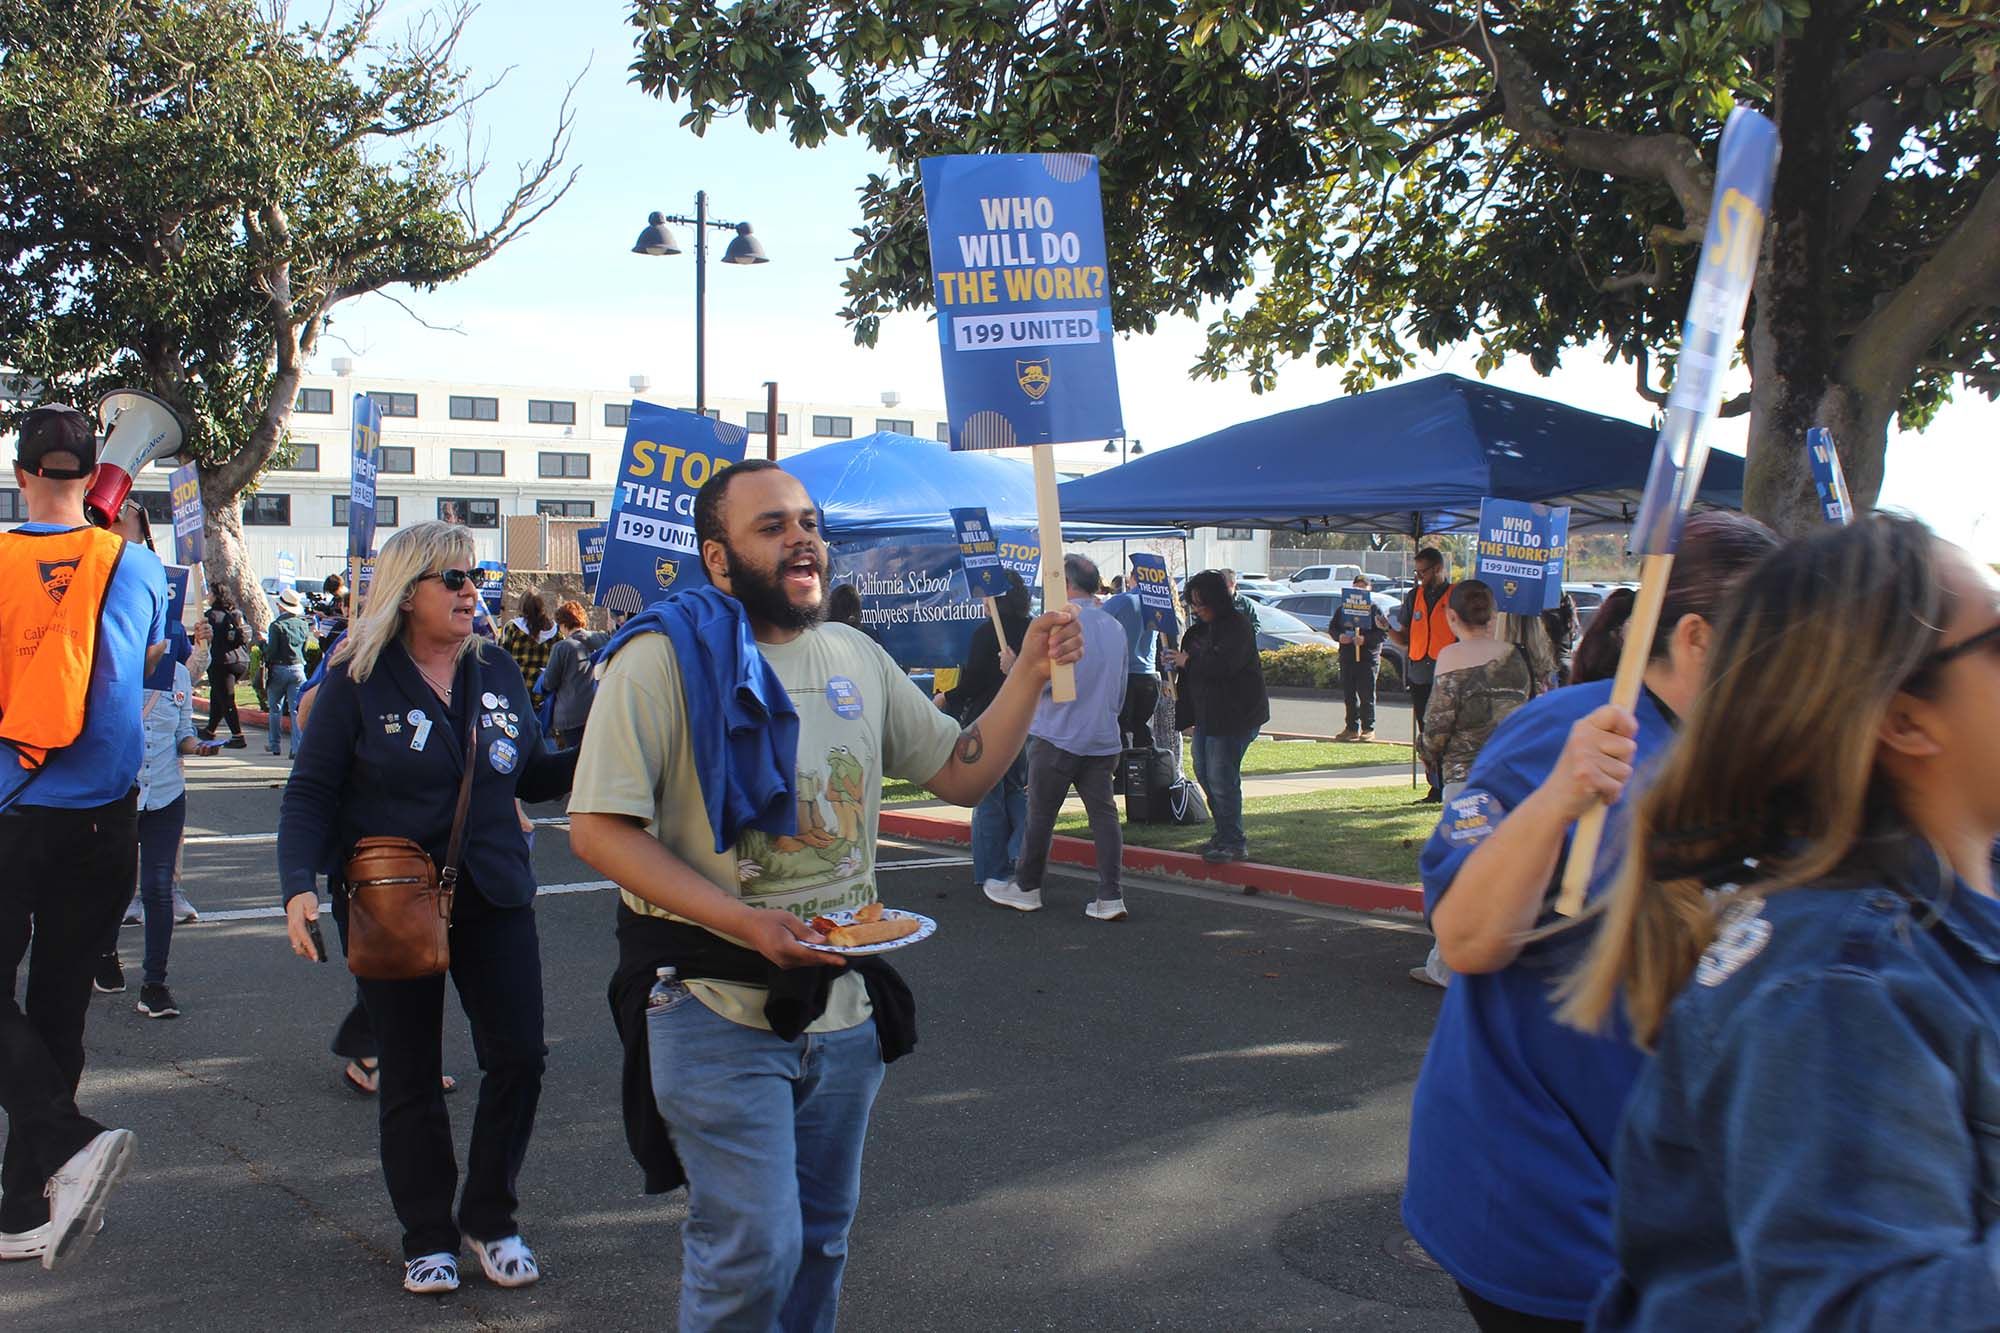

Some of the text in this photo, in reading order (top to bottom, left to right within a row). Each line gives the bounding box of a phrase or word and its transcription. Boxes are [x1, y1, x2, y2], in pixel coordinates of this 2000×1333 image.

[980, 197, 1054, 231] WHO
[959, 231, 1080, 268] WILL DO
[938, 266, 1105, 305] THE WORK?
[962, 318, 1093, 345] 199 UNITED
[173, 479, 198, 507] STOP
[622, 481, 671, 511] THE
[185, 499, 201, 514] CUTS
[622, 520, 698, 548] 199 UNIT
[1502, 516, 1532, 533] WHO
[1490, 528, 1541, 548] WILL DO
[998, 543, 1040, 560] STOP
[1480, 541, 1549, 562] THE WORK?
[484, 570, 503, 581] TOP
[1013, 561, 1037, 573] CUTS
[1136, 566, 1166, 584] STOP
[1485, 562, 1502, 571] 199
[1504, 564, 1540, 576] UNITED
[856, 568, 953, 596] California School
[1138, 582, 1170, 595] THE CUTS
[861, 599, 987, 630] mployees Association
[821, 893, 845, 909] and
